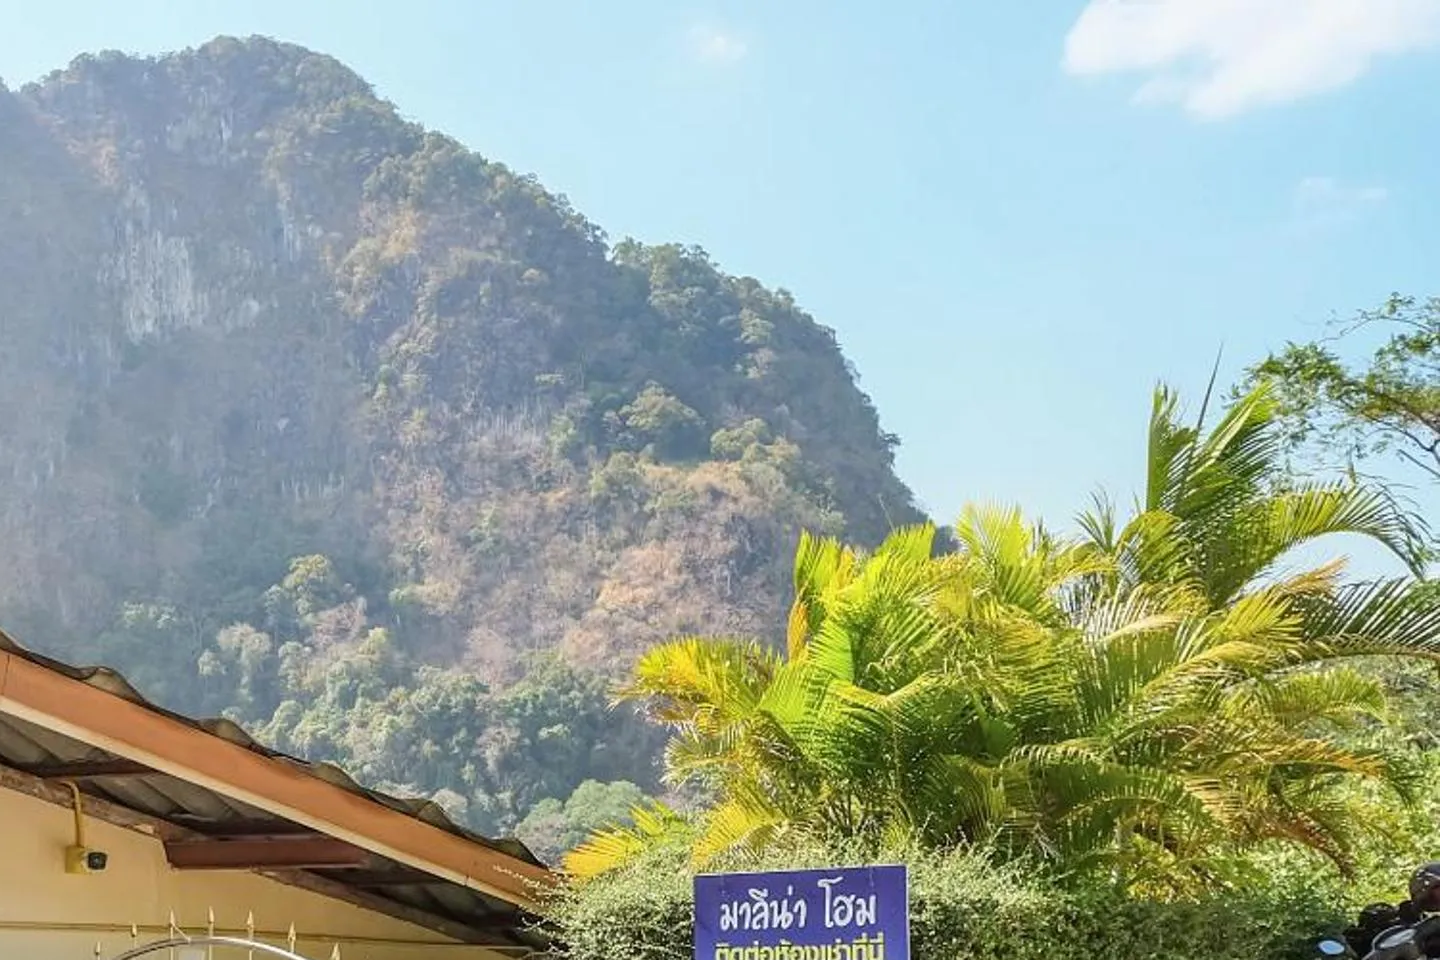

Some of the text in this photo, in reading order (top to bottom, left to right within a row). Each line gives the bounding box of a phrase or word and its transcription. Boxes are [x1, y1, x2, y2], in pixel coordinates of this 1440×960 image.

[720, 876, 876, 931] มาลีน่า โฮม
